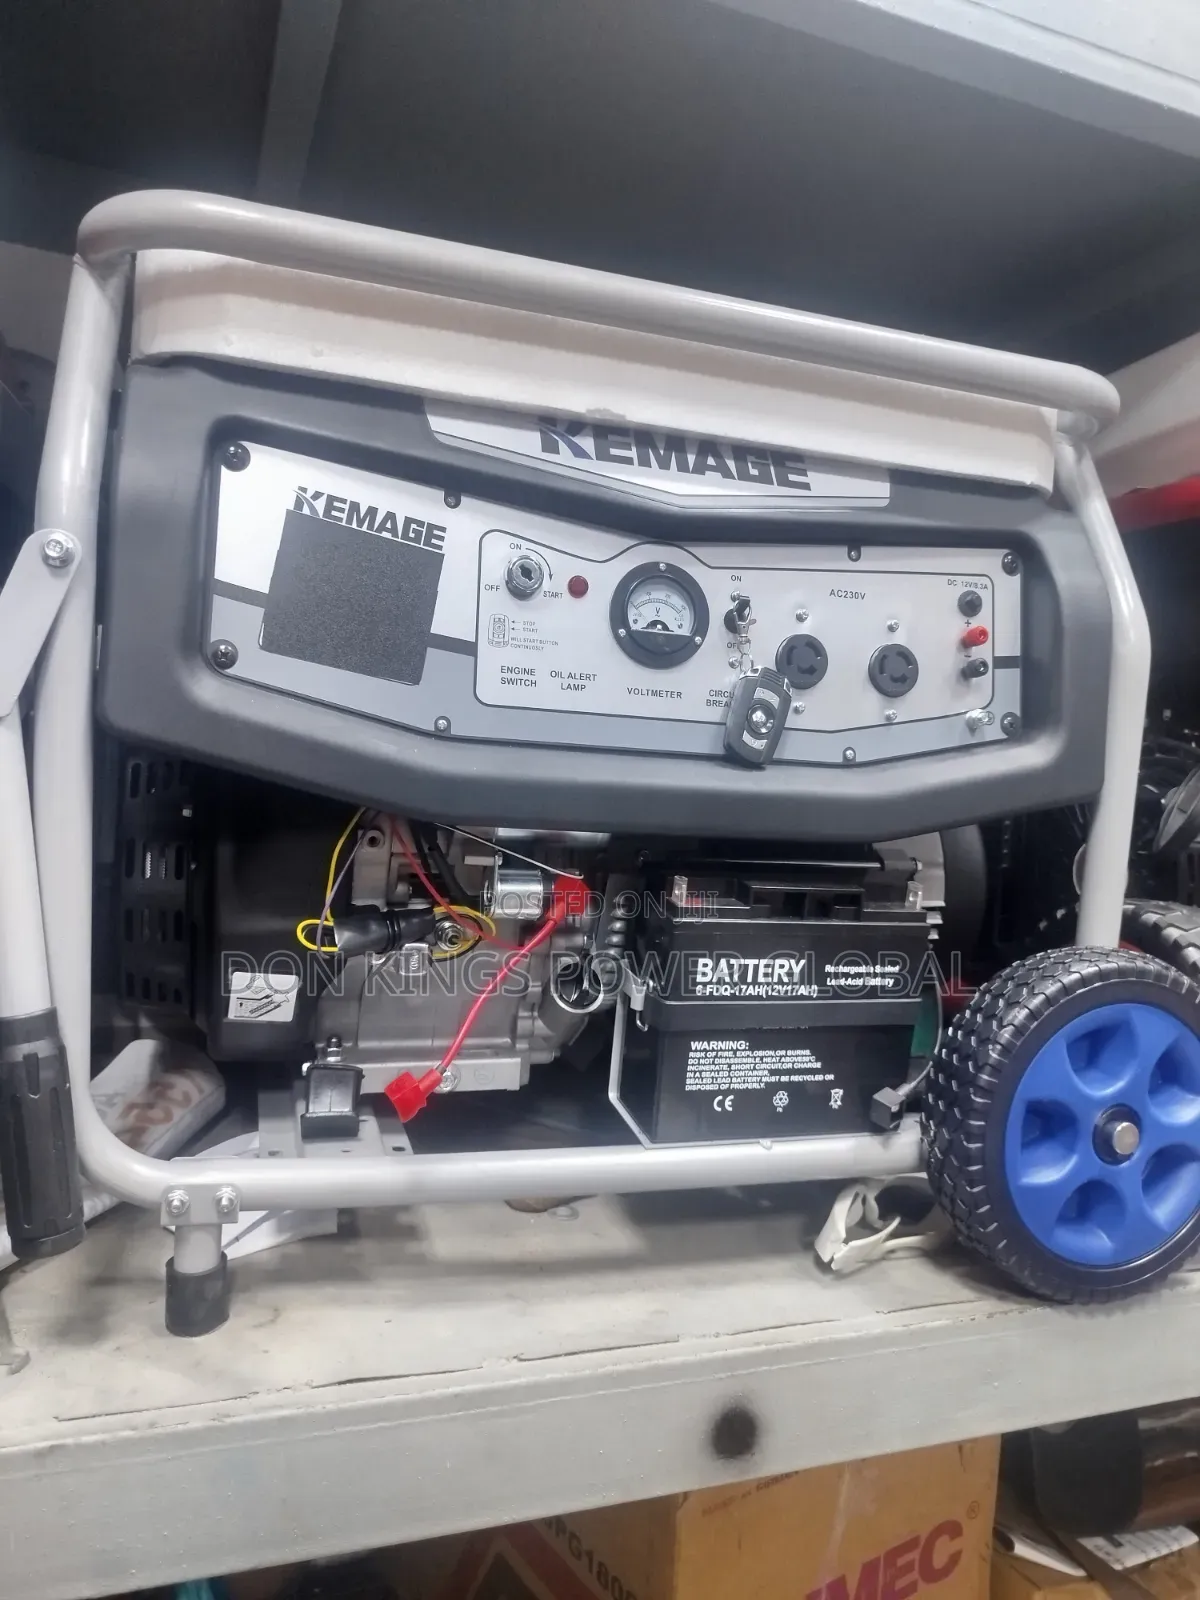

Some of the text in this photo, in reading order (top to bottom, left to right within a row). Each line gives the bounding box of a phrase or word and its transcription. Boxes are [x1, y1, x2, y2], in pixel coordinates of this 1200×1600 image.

[537, 416, 812, 491] KEMAGE
[293, 486, 447, 551] KEMAGE
[509, 542, 522, 551] ON
[484, 584, 501, 592] OFF
[829, 588, 866, 600] AC230V
[543, 590, 563, 599] START
[500, 665, 536, 676] ENGINE
[550, 670, 597, 682] OIL ALERT
[500, 676, 537, 687] SWITCH
[560, 683, 586, 692] LAMP
[627, 687, 682, 699] VOLTMETER
[696, 958, 805, 983] BATTERY
[825, 964, 873, 974] Rechargeable
[827, 977, 894, 987] Lead-Acid Battery
[696, 985, 818, 998] 6-FDQ-17AH(12V17AH)
[691, 1041, 749, 1050] WARNING:
[713, 1095, 734, 1112] CE
[544, 1516, 638, 1600] PG180
[806, 1519, 964, 1600] MEC
